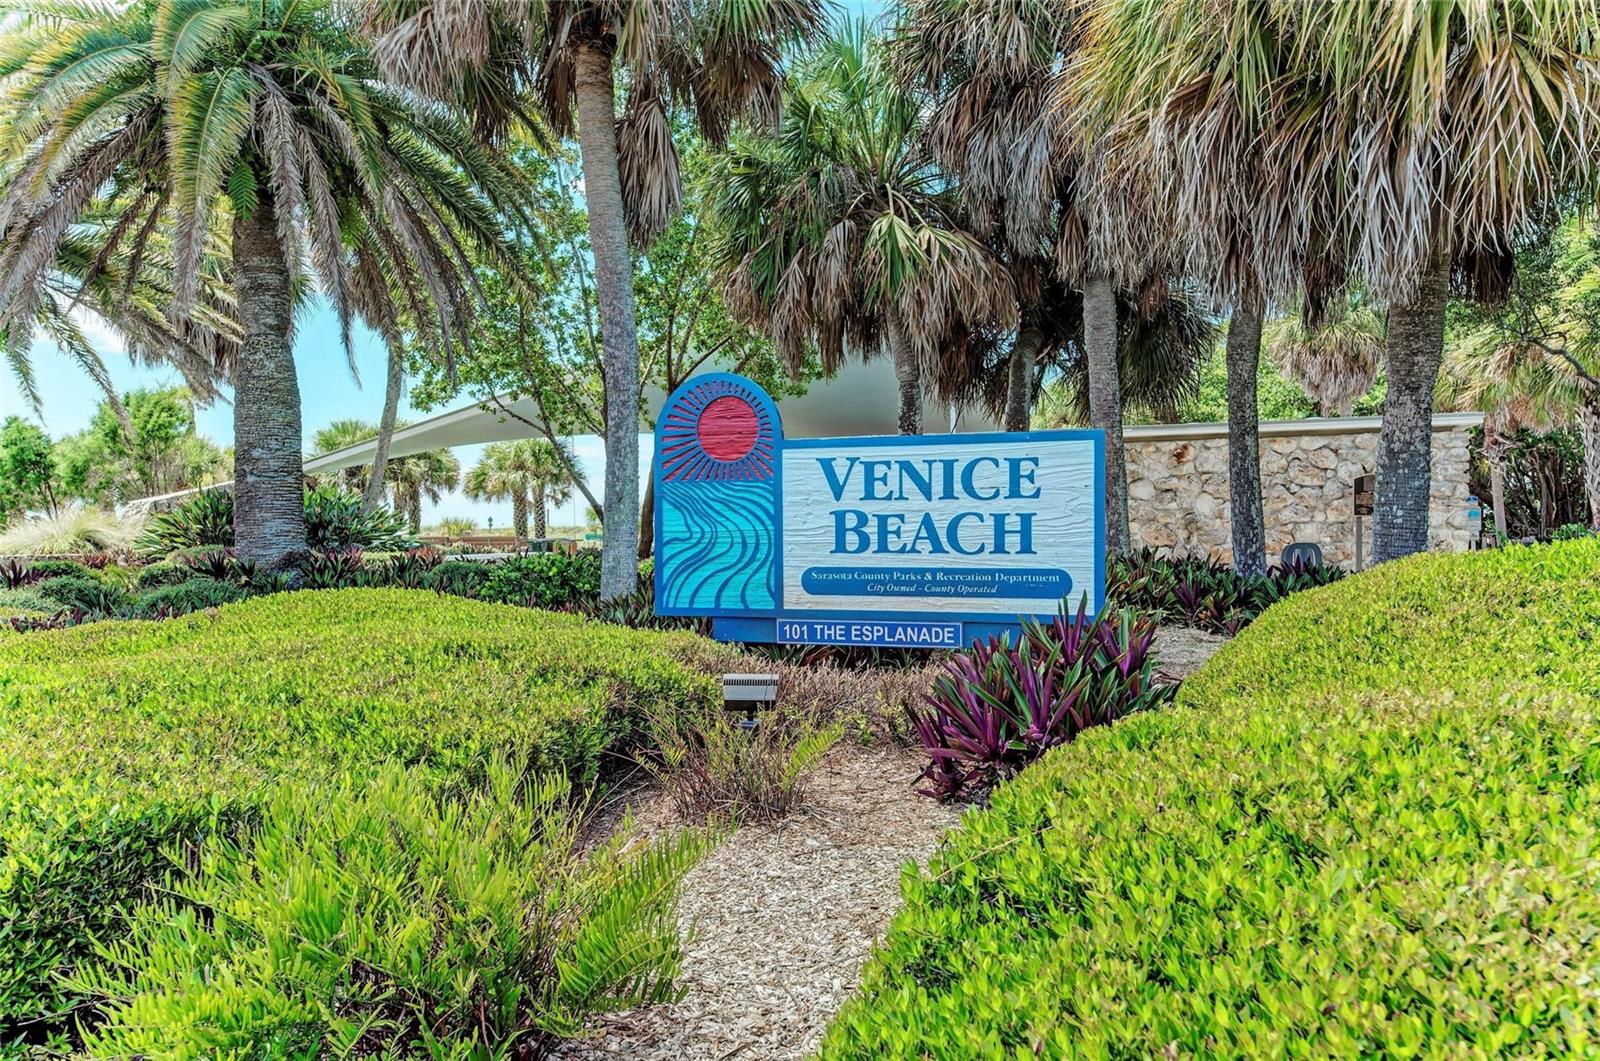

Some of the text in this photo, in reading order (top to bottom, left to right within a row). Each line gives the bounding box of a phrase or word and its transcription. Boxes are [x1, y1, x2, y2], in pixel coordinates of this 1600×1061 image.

[816, 456, 1041, 502] VENICE
[829, 509, 1038, 555] BEACH
[811, 571, 1060, 583] Sarasota County Parks & Recreation Department
[867, 583, 885, 594] City
[887, 583, 917, 592] Owned
[925, 584, 955, 594] County
[957, 584, 999, 595] Operated
[783, 624, 955, 643] 101 THE ESPLANADE
